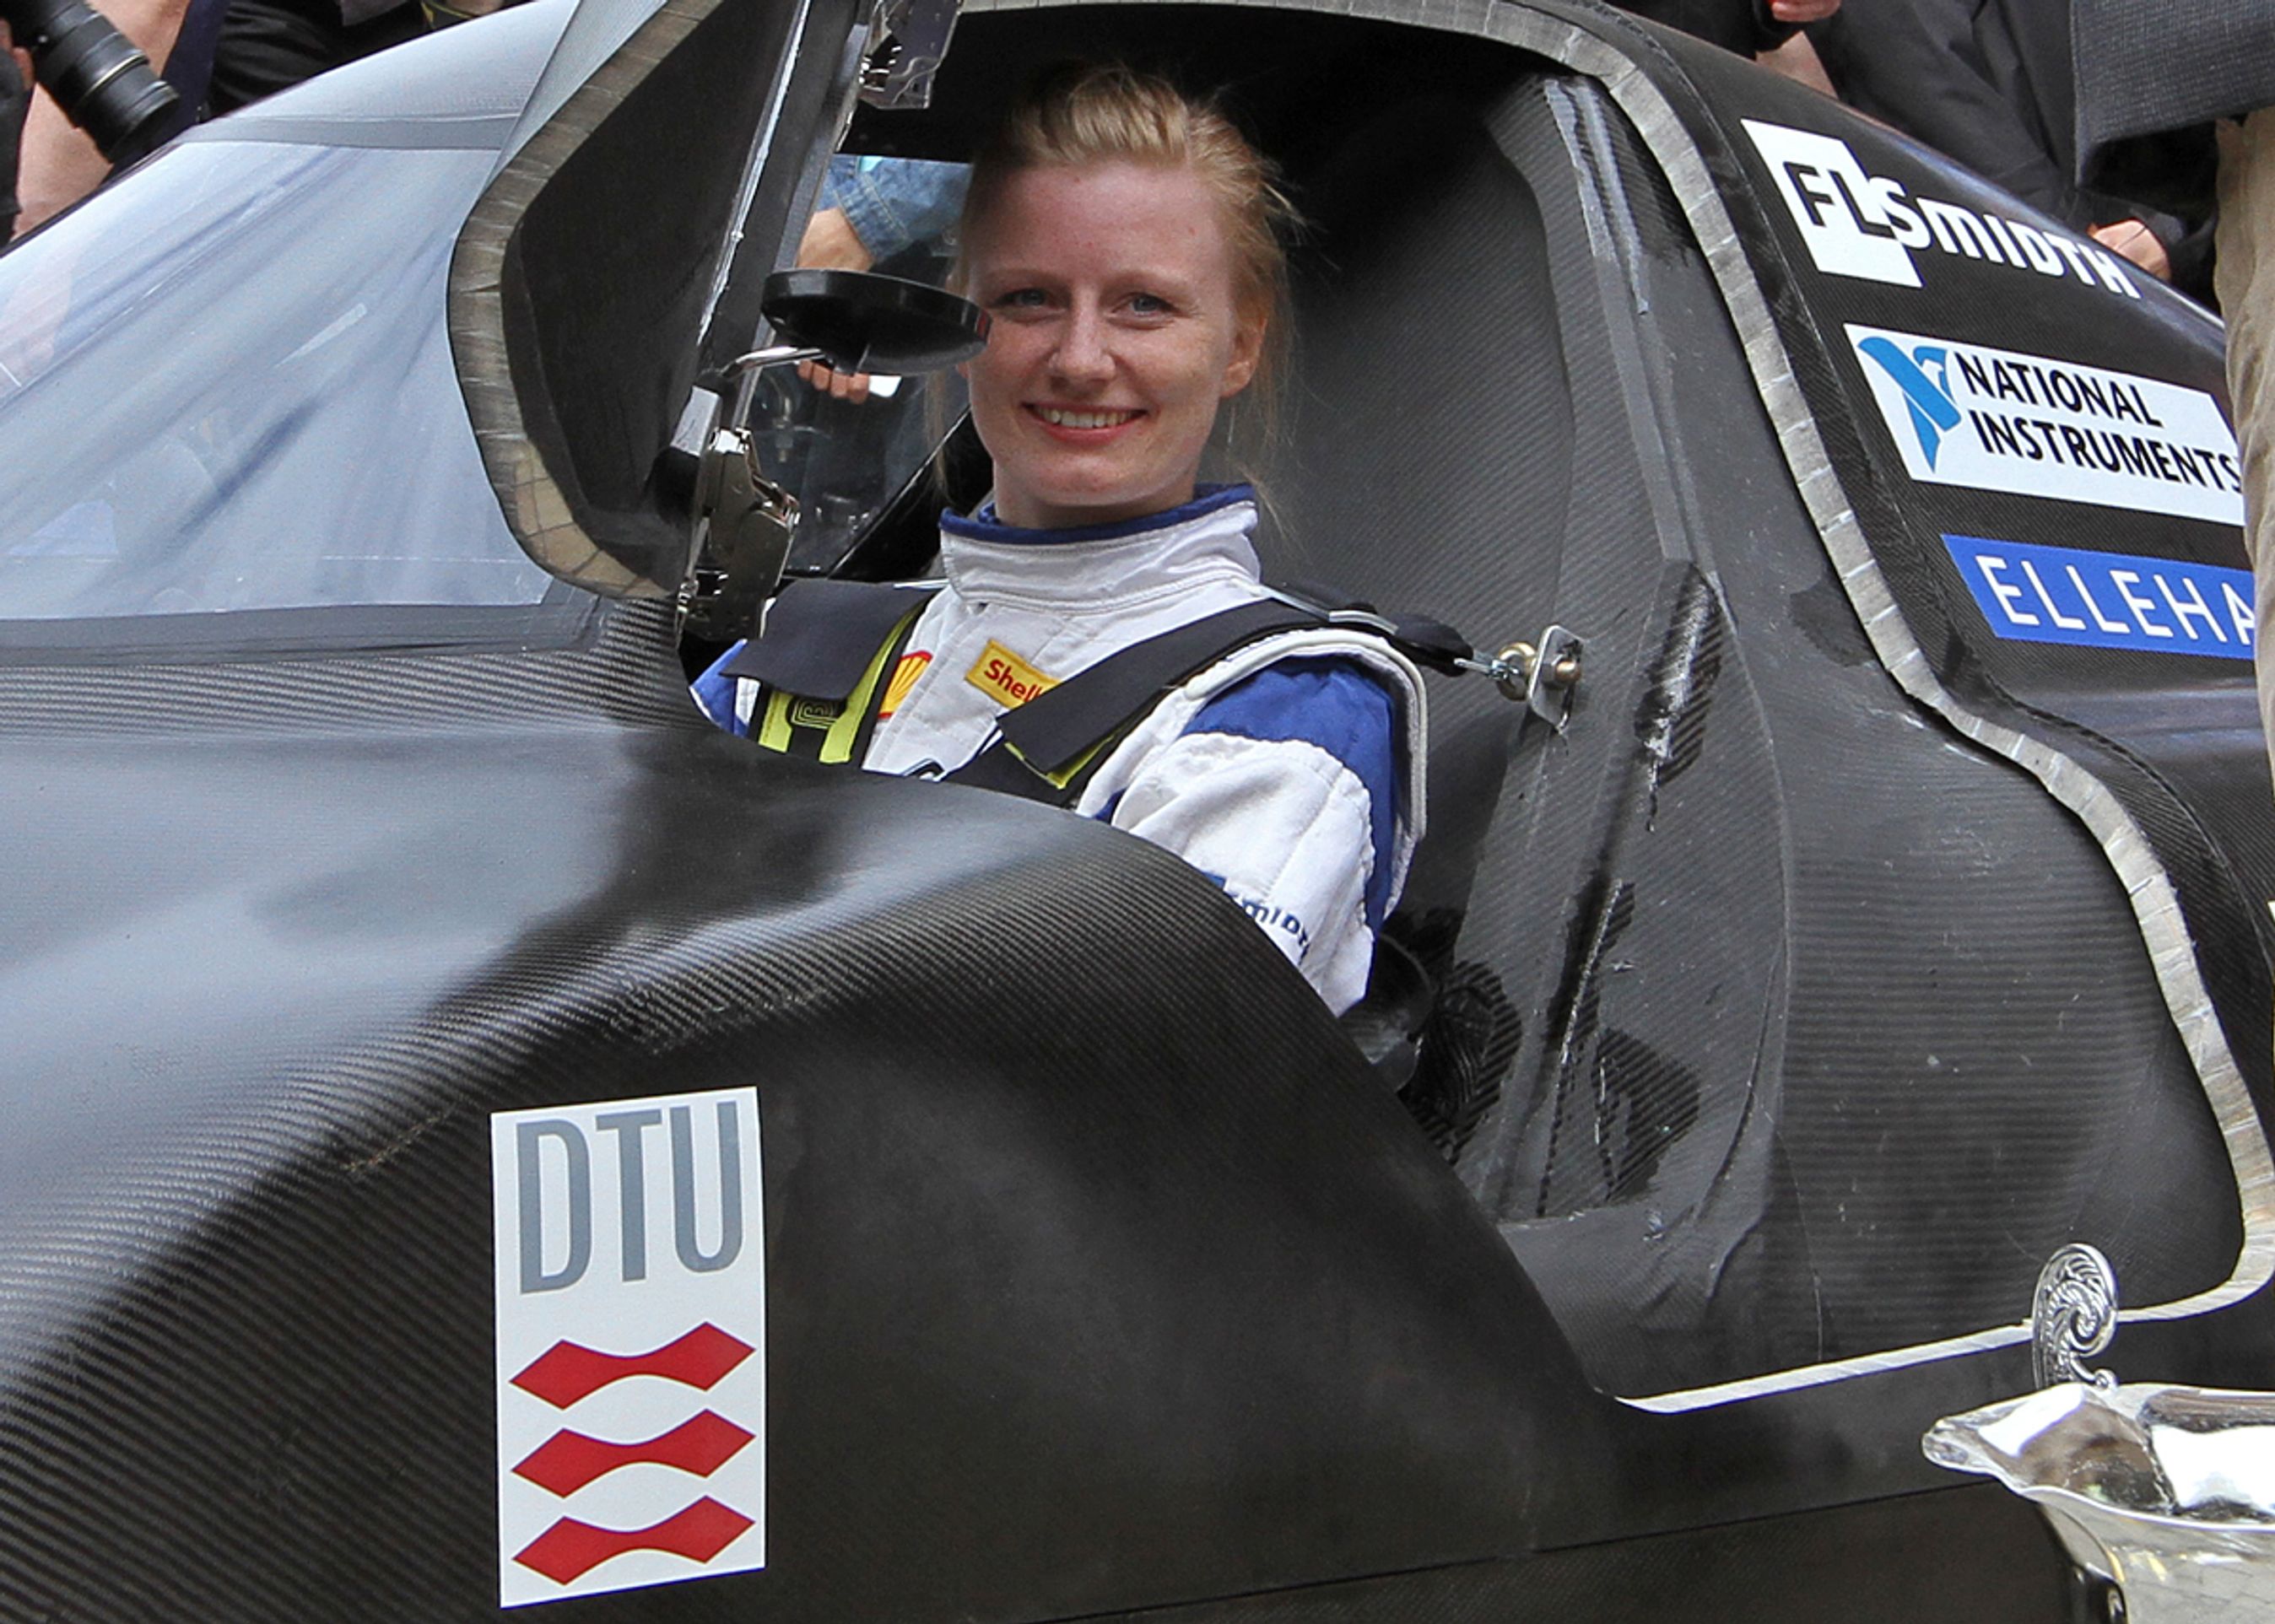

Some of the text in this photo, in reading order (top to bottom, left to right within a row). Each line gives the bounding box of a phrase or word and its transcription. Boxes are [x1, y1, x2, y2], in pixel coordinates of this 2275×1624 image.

[1954, 351, 2164, 429] NATIONAL
[1969, 409, 2242, 494] INSTRUMENTS
[516, 1100, 743, 1294] DTU
